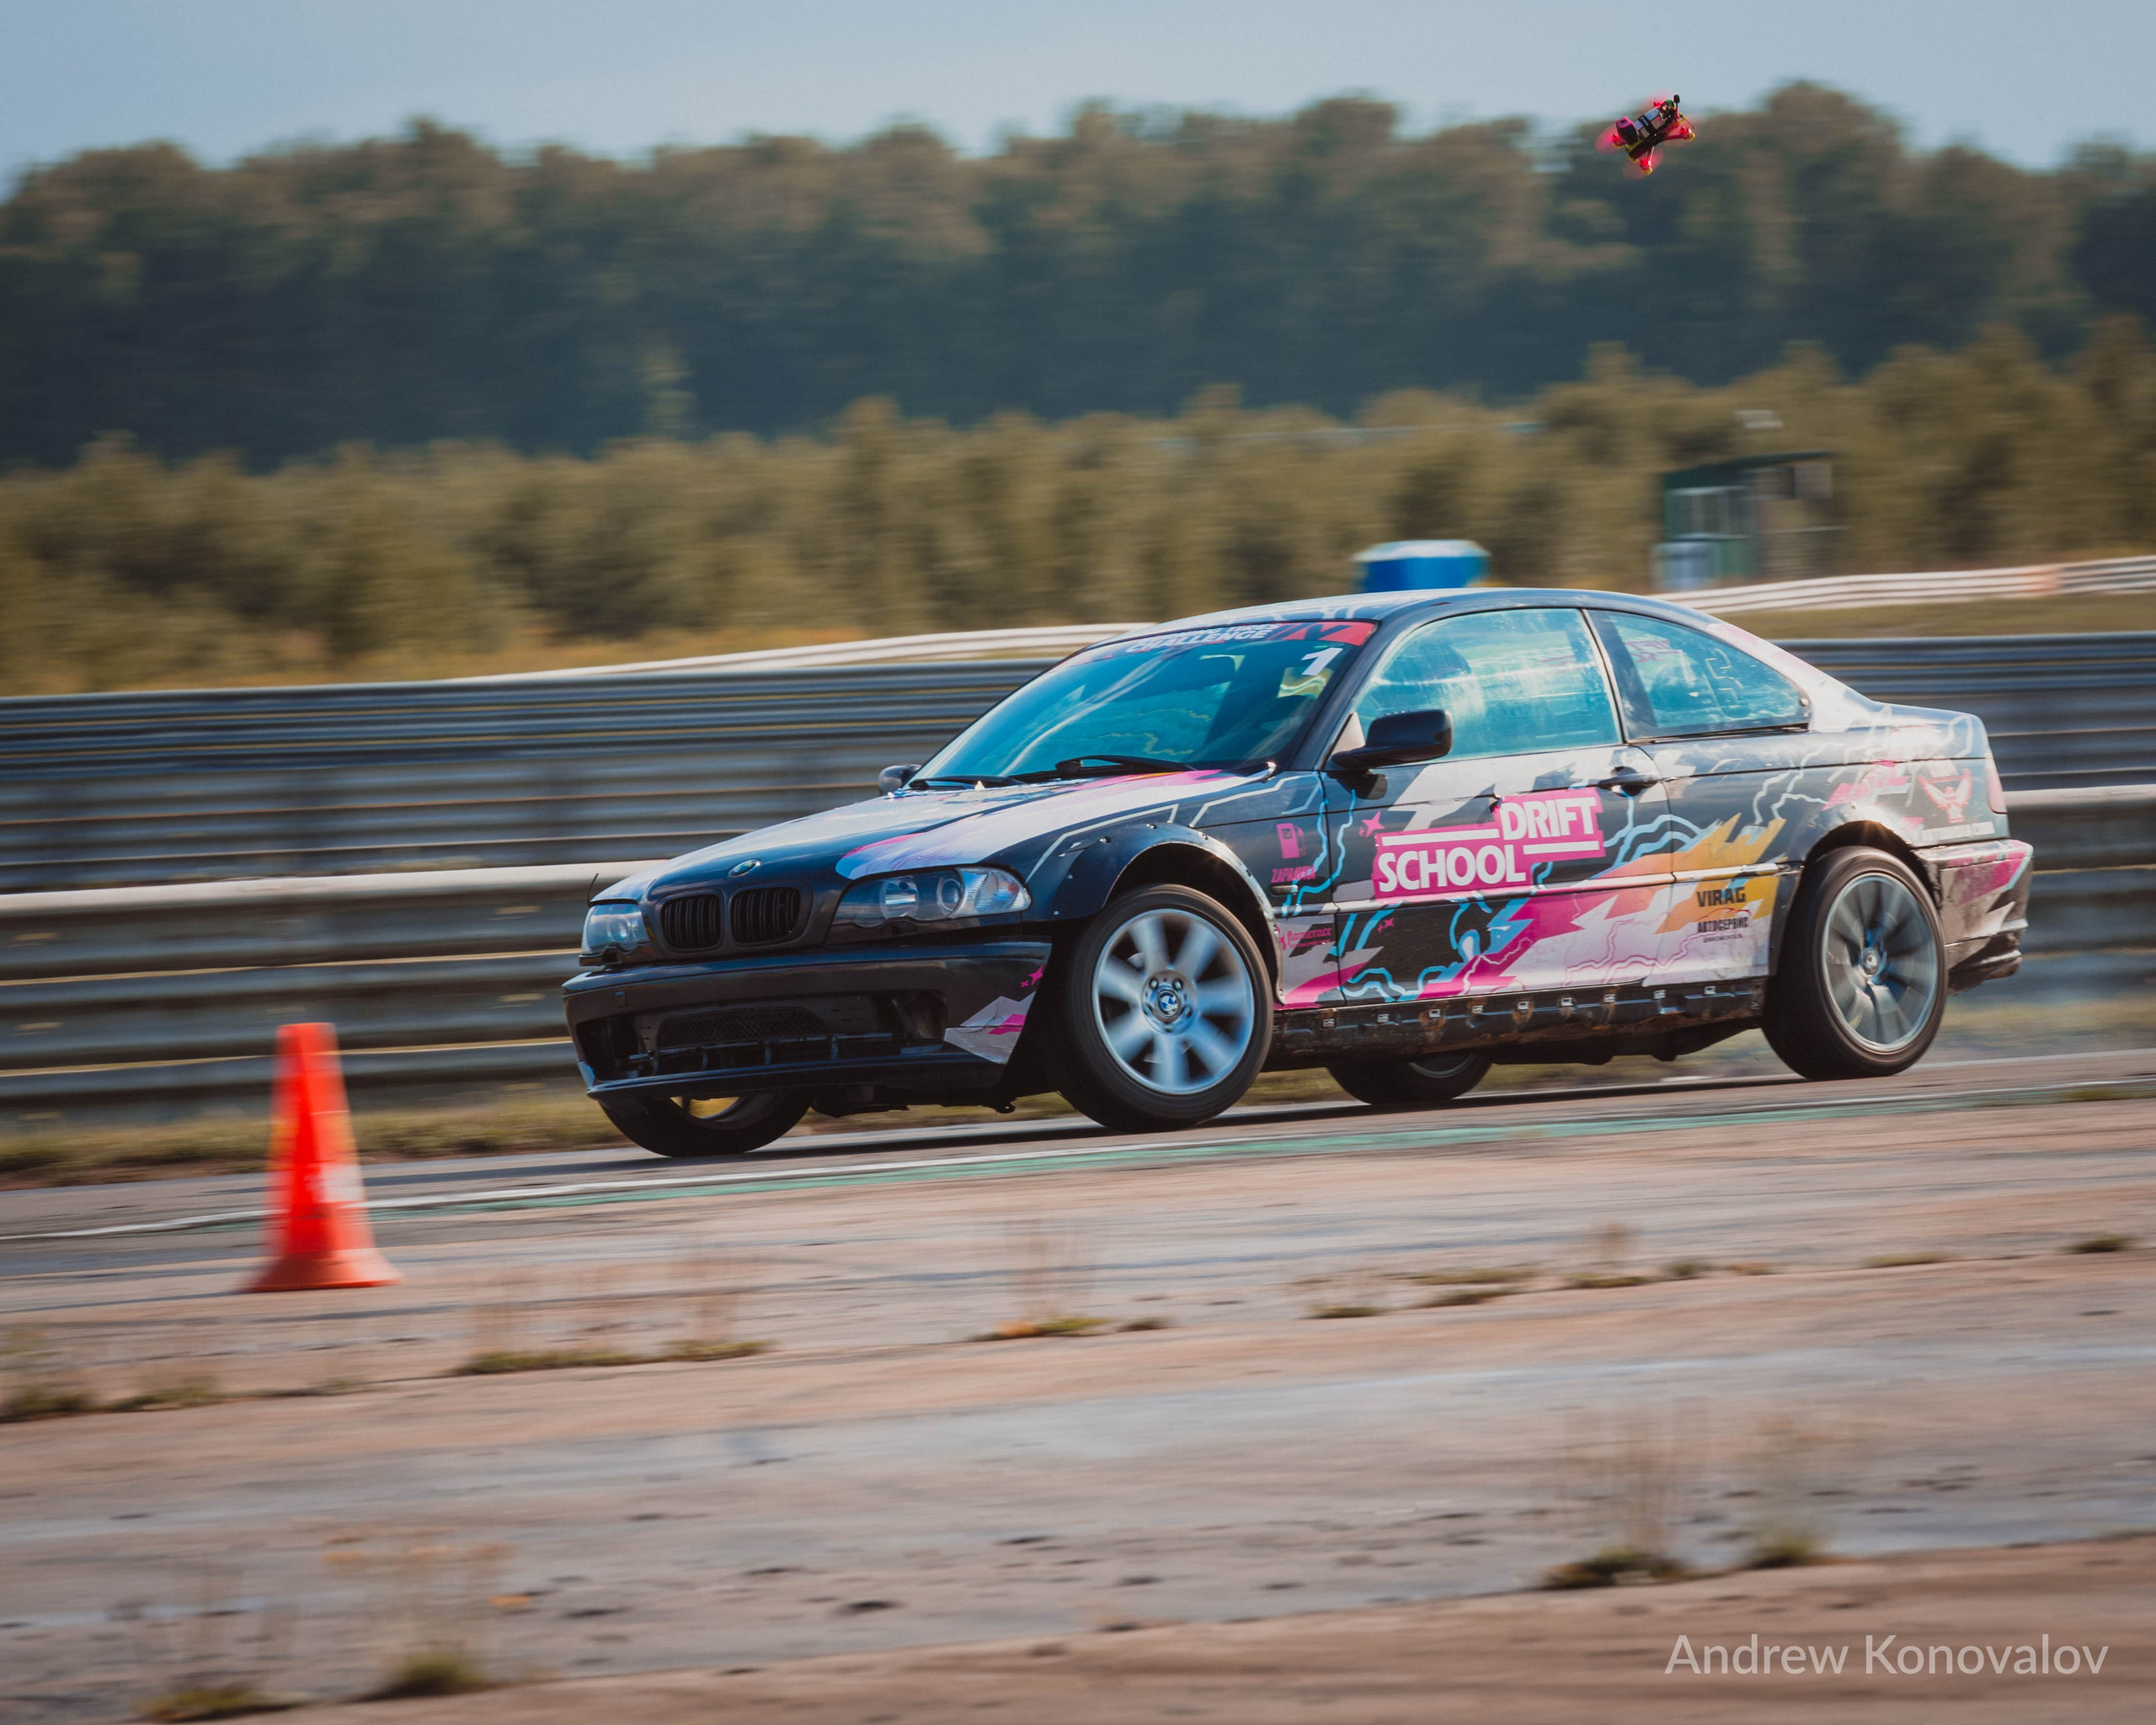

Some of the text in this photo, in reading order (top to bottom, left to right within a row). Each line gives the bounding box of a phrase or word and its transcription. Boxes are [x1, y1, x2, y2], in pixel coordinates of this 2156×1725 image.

[1126, 629, 1273, 653] CHALLENGE
[1300, 647, 1343, 676] 1
[1499, 797, 1597, 841] DRIFT
[1378, 844, 1527, 892] SCHOOL
[1697, 887, 1746, 907] VIRAG
